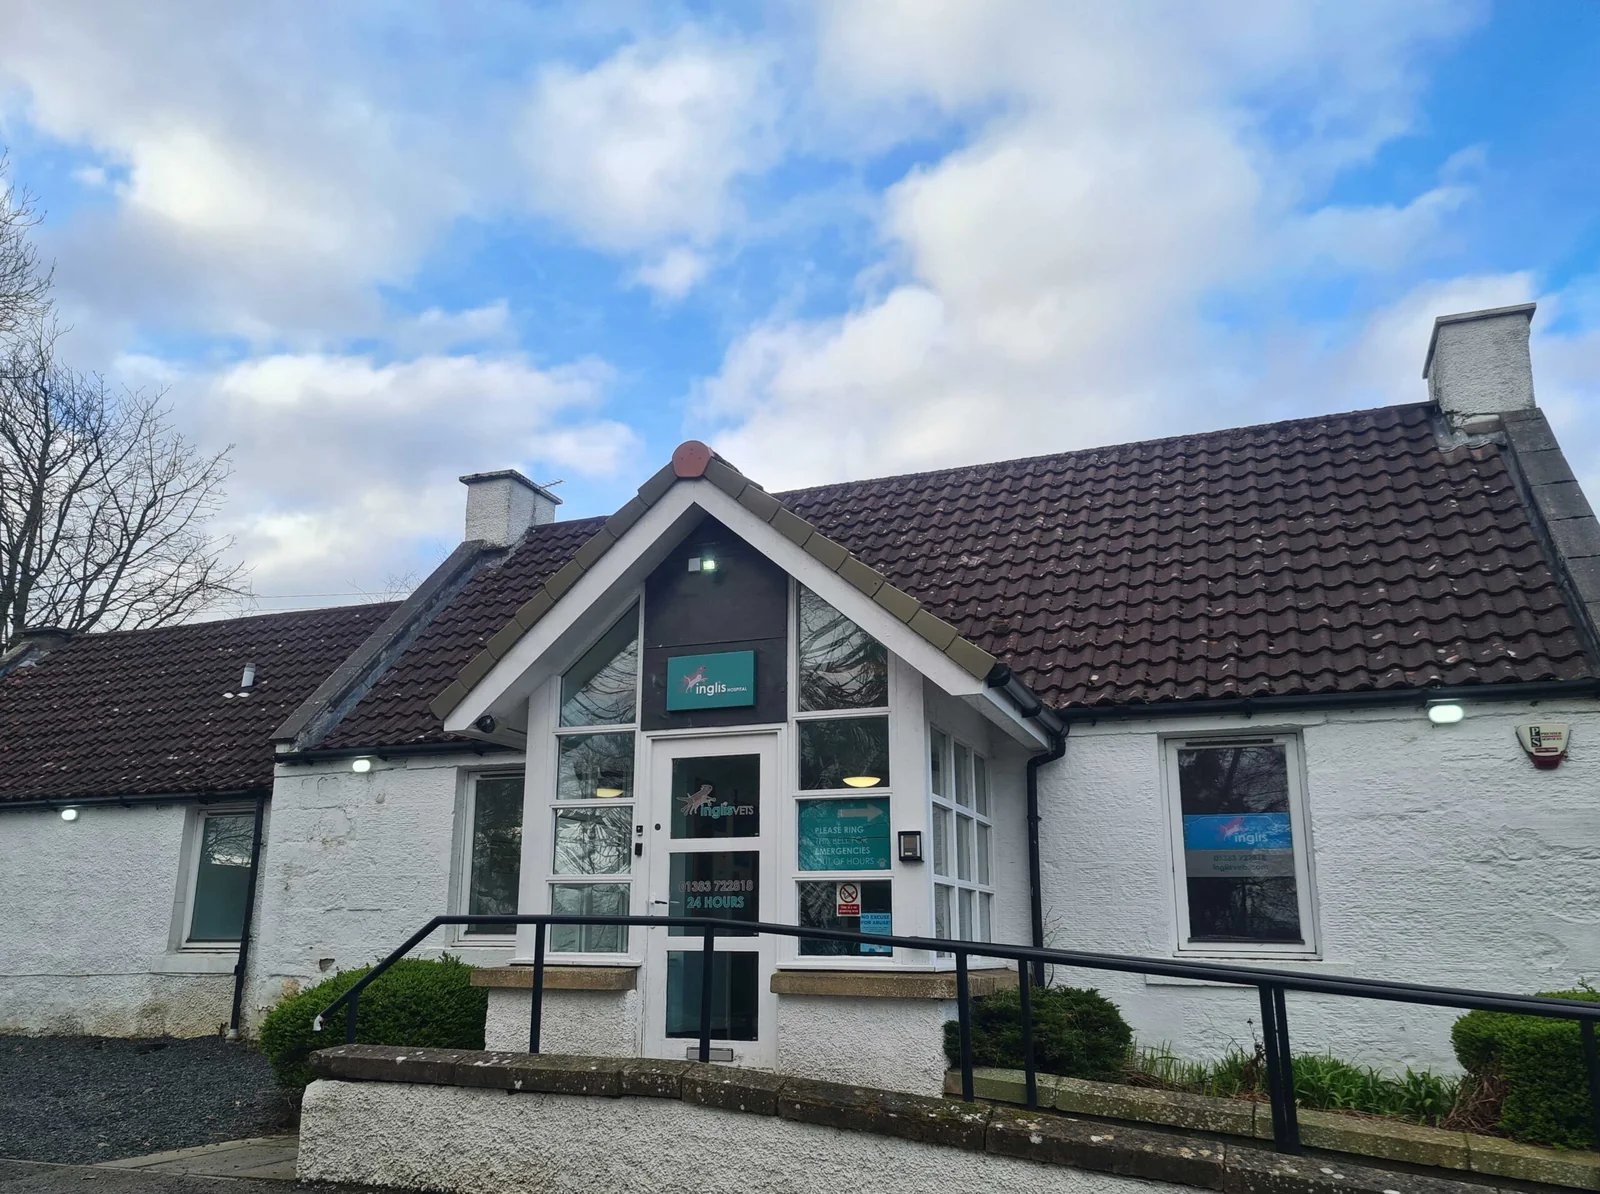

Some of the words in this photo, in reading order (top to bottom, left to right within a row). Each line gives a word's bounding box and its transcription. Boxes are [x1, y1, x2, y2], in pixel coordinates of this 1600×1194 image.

[695, 682, 727, 696] inglis
[814, 826, 842, 834] PLEASE
[843, 825, 864, 834] RING
[1234, 832, 1268, 844] inglis
[814, 847, 870, 856] EMERGENCIES
[833, 858, 845, 866] OF
[846, 857, 874, 865] HOURS
[680, 880, 712, 892] 01383
[714, 879, 754, 892] 722818
[686, 896, 702, 908] 24
[704, 896, 744, 908] HOURS
